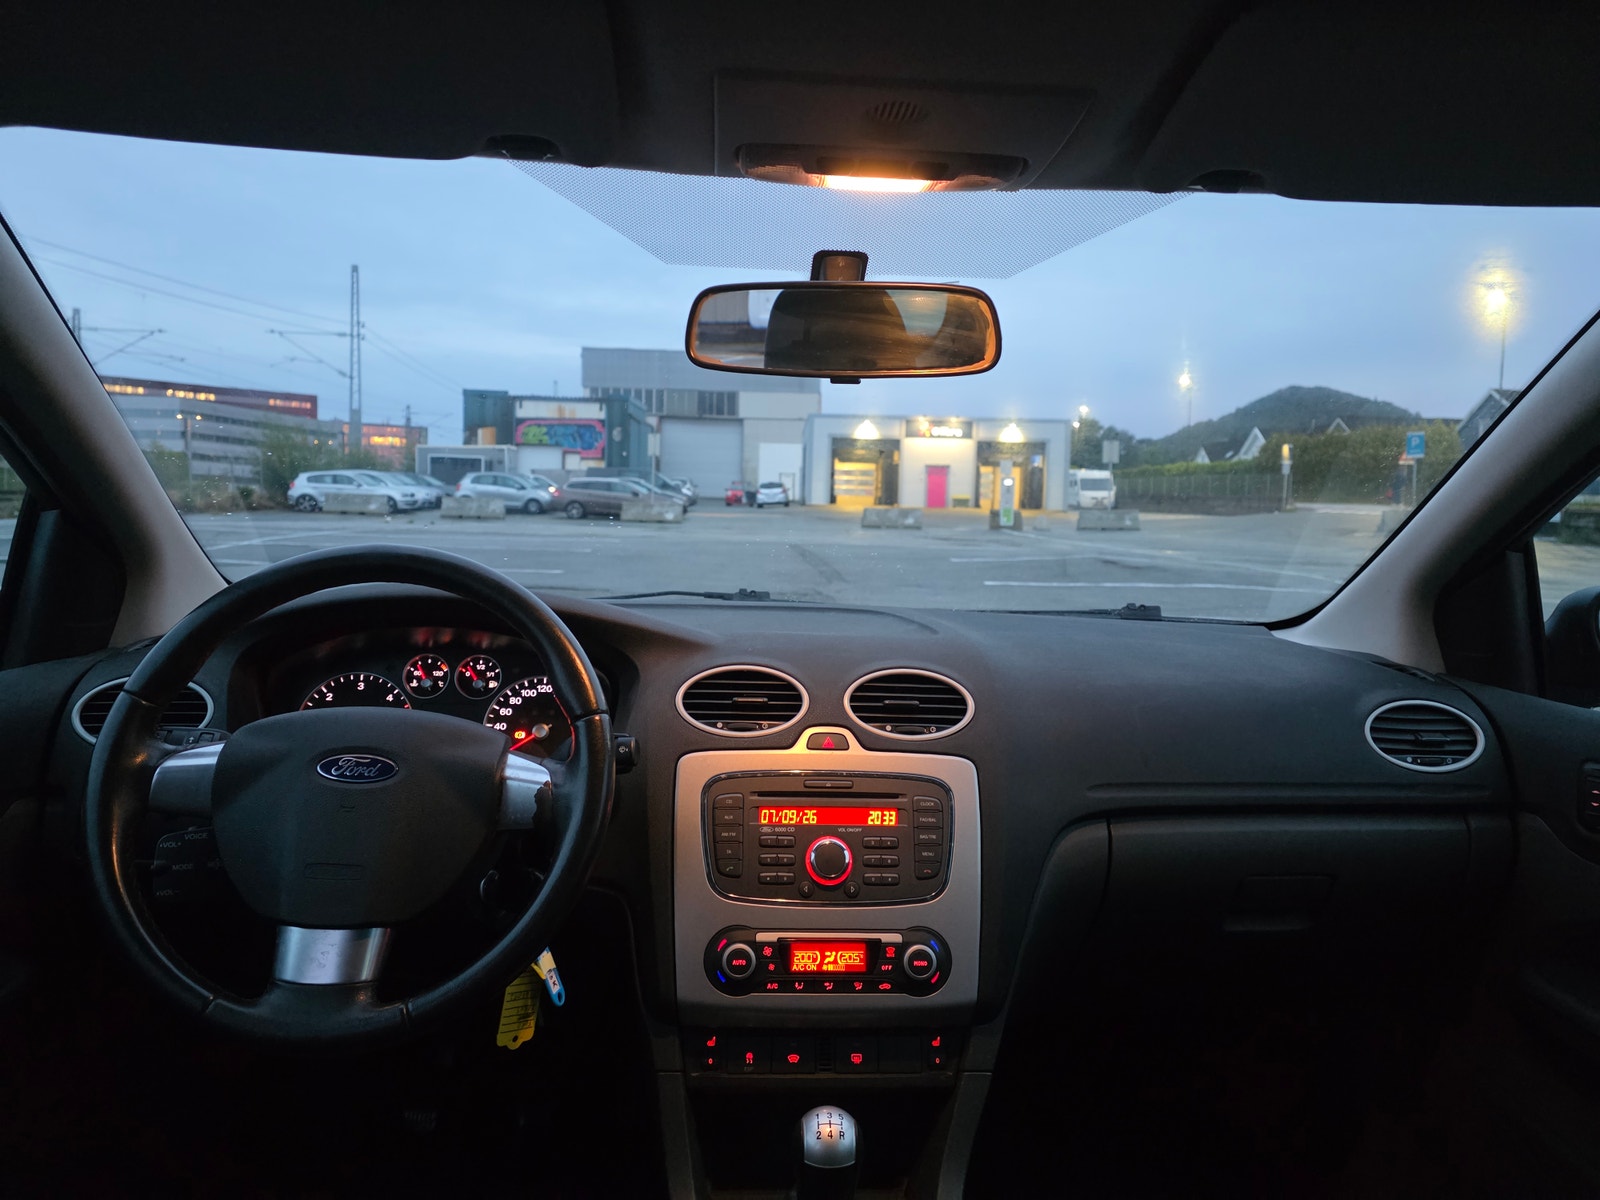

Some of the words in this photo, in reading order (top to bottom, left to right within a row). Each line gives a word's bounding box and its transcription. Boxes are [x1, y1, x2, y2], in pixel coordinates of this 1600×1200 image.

[356, 682, 365, 690] 3
[536, 684, 553, 693] 120
[325, 692, 334, 701] 2
[386, 693, 394, 702] 4
[520, 689, 537, 697] 100
[509, 696, 522, 705] 80
[499, 708, 513, 716] 60
[493, 722, 507, 731] 40
[331, 757, 382, 777] Ford
[760, 809, 817, 824] 07/09/26
[184, 832, 209, 840] VOICE
[816, 1130, 822, 1140] 2
[827, 1130, 834, 1139] 4
[839, 1130, 845, 1140] R
